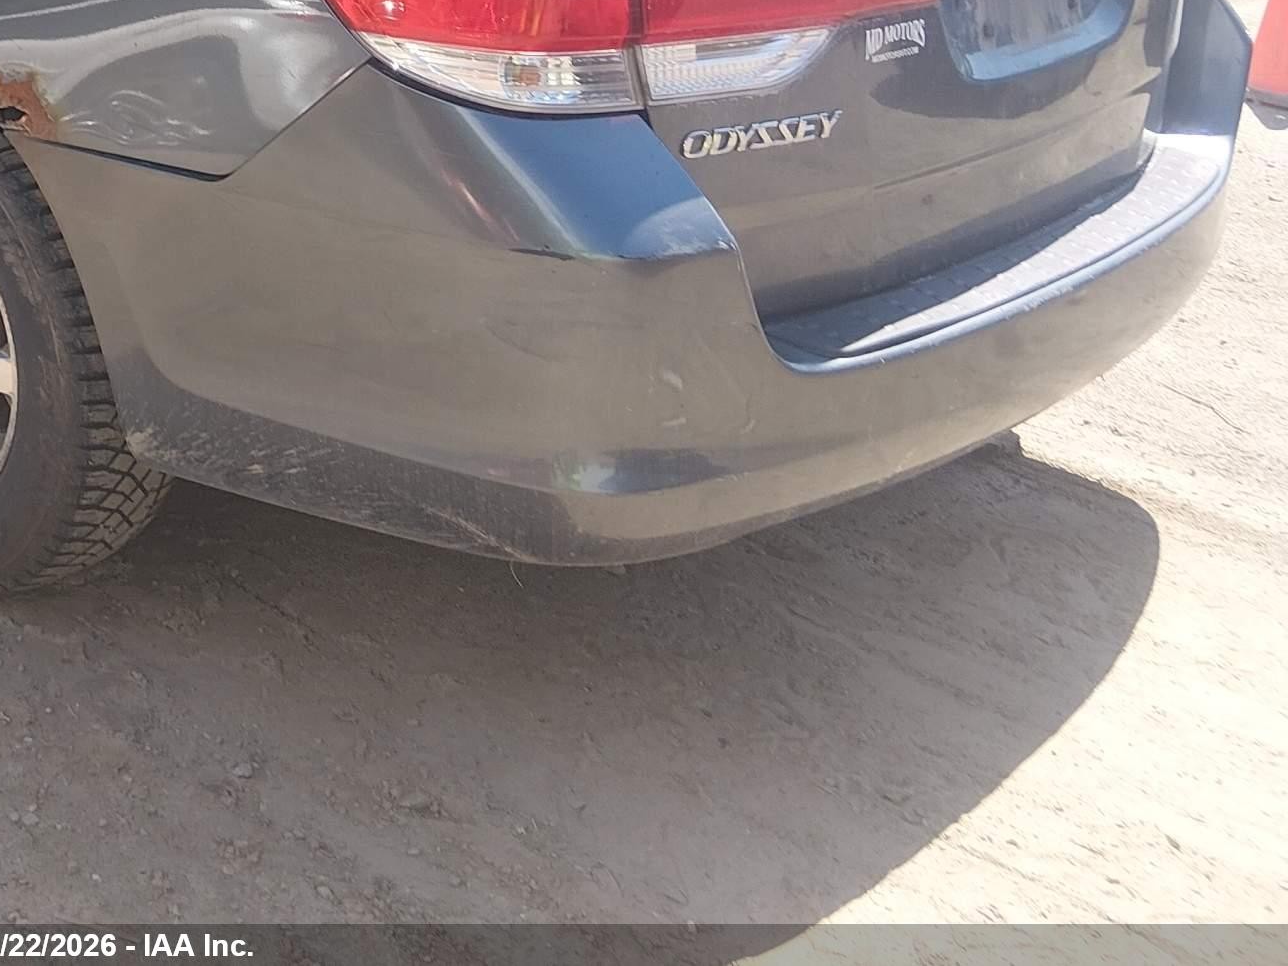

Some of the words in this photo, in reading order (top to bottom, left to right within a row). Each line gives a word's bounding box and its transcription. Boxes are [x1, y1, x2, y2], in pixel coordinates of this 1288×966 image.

[865, 28, 883, 61] MD
[884, 18, 926, 48] MOTORS
[682, 109, 844, 160] ODYSSEY
